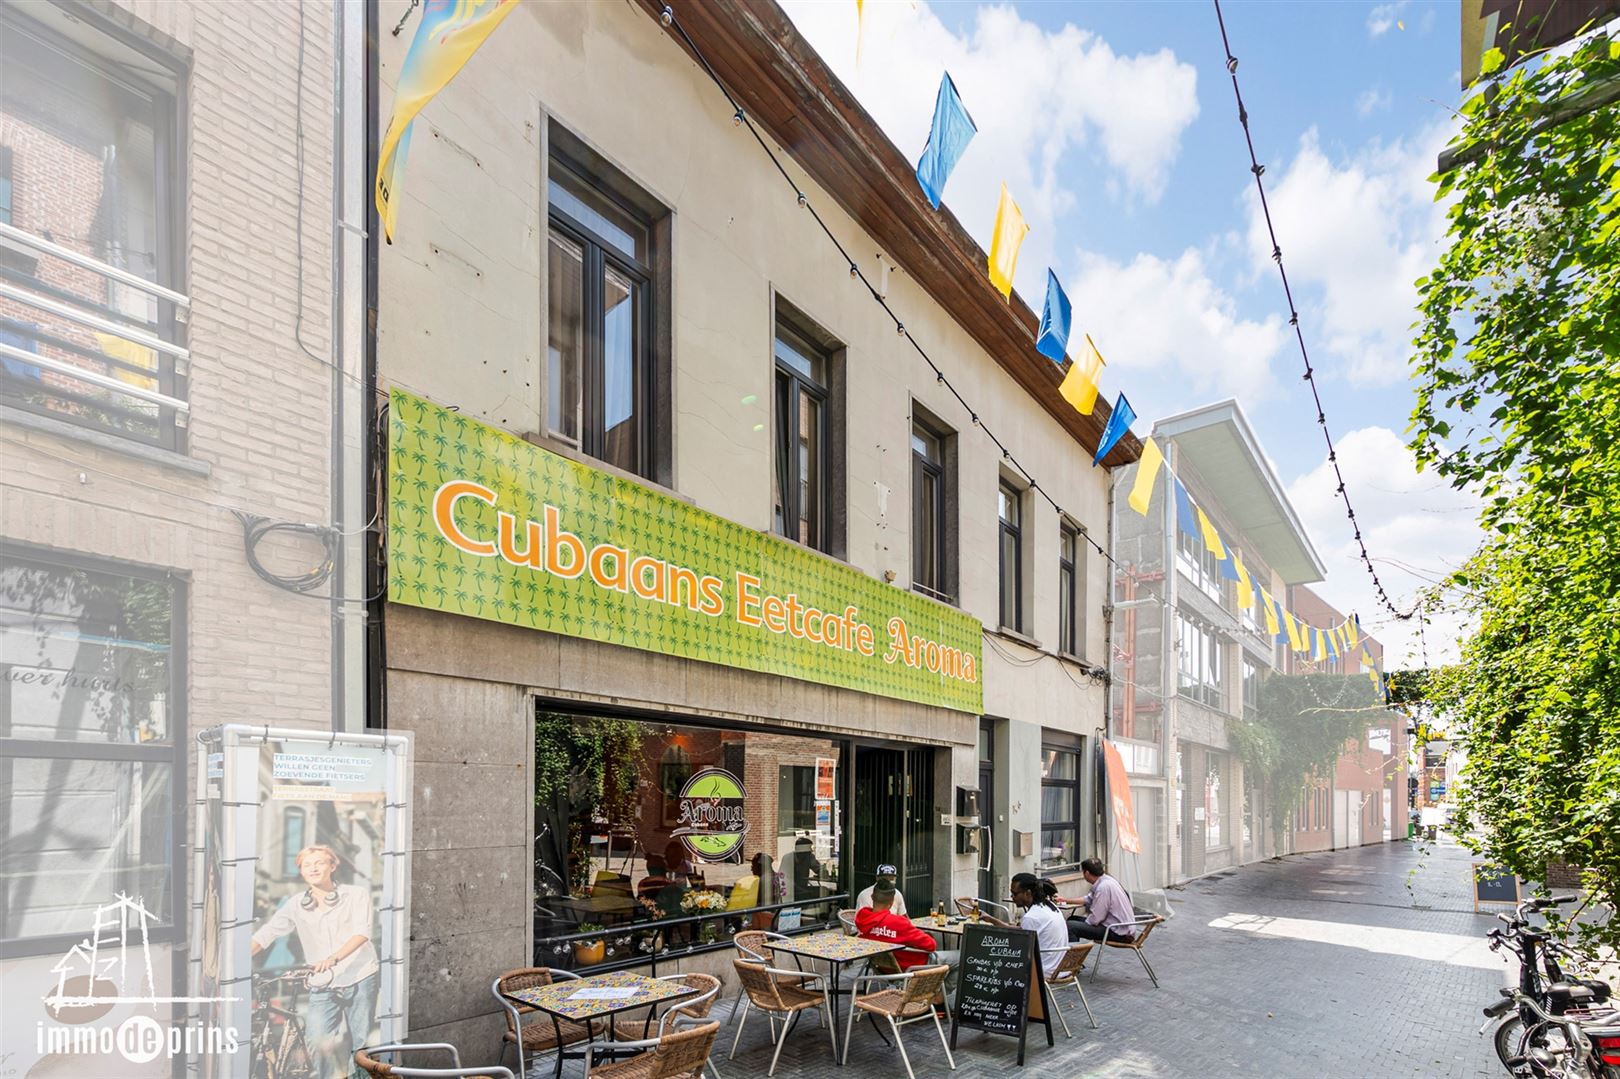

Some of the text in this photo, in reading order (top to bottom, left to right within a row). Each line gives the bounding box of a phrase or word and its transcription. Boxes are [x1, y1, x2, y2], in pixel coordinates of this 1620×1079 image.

[433, 479, 977, 684] Cubaans Eetcafe Aroma
[275, 754, 372, 765] TERRASJESGENIETERS
[275, 763, 309, 771] WILLEN
[274, 771, 366, 780] ZOEVENDE FIETSERS
[677, 799, 746, 823] Aroma
